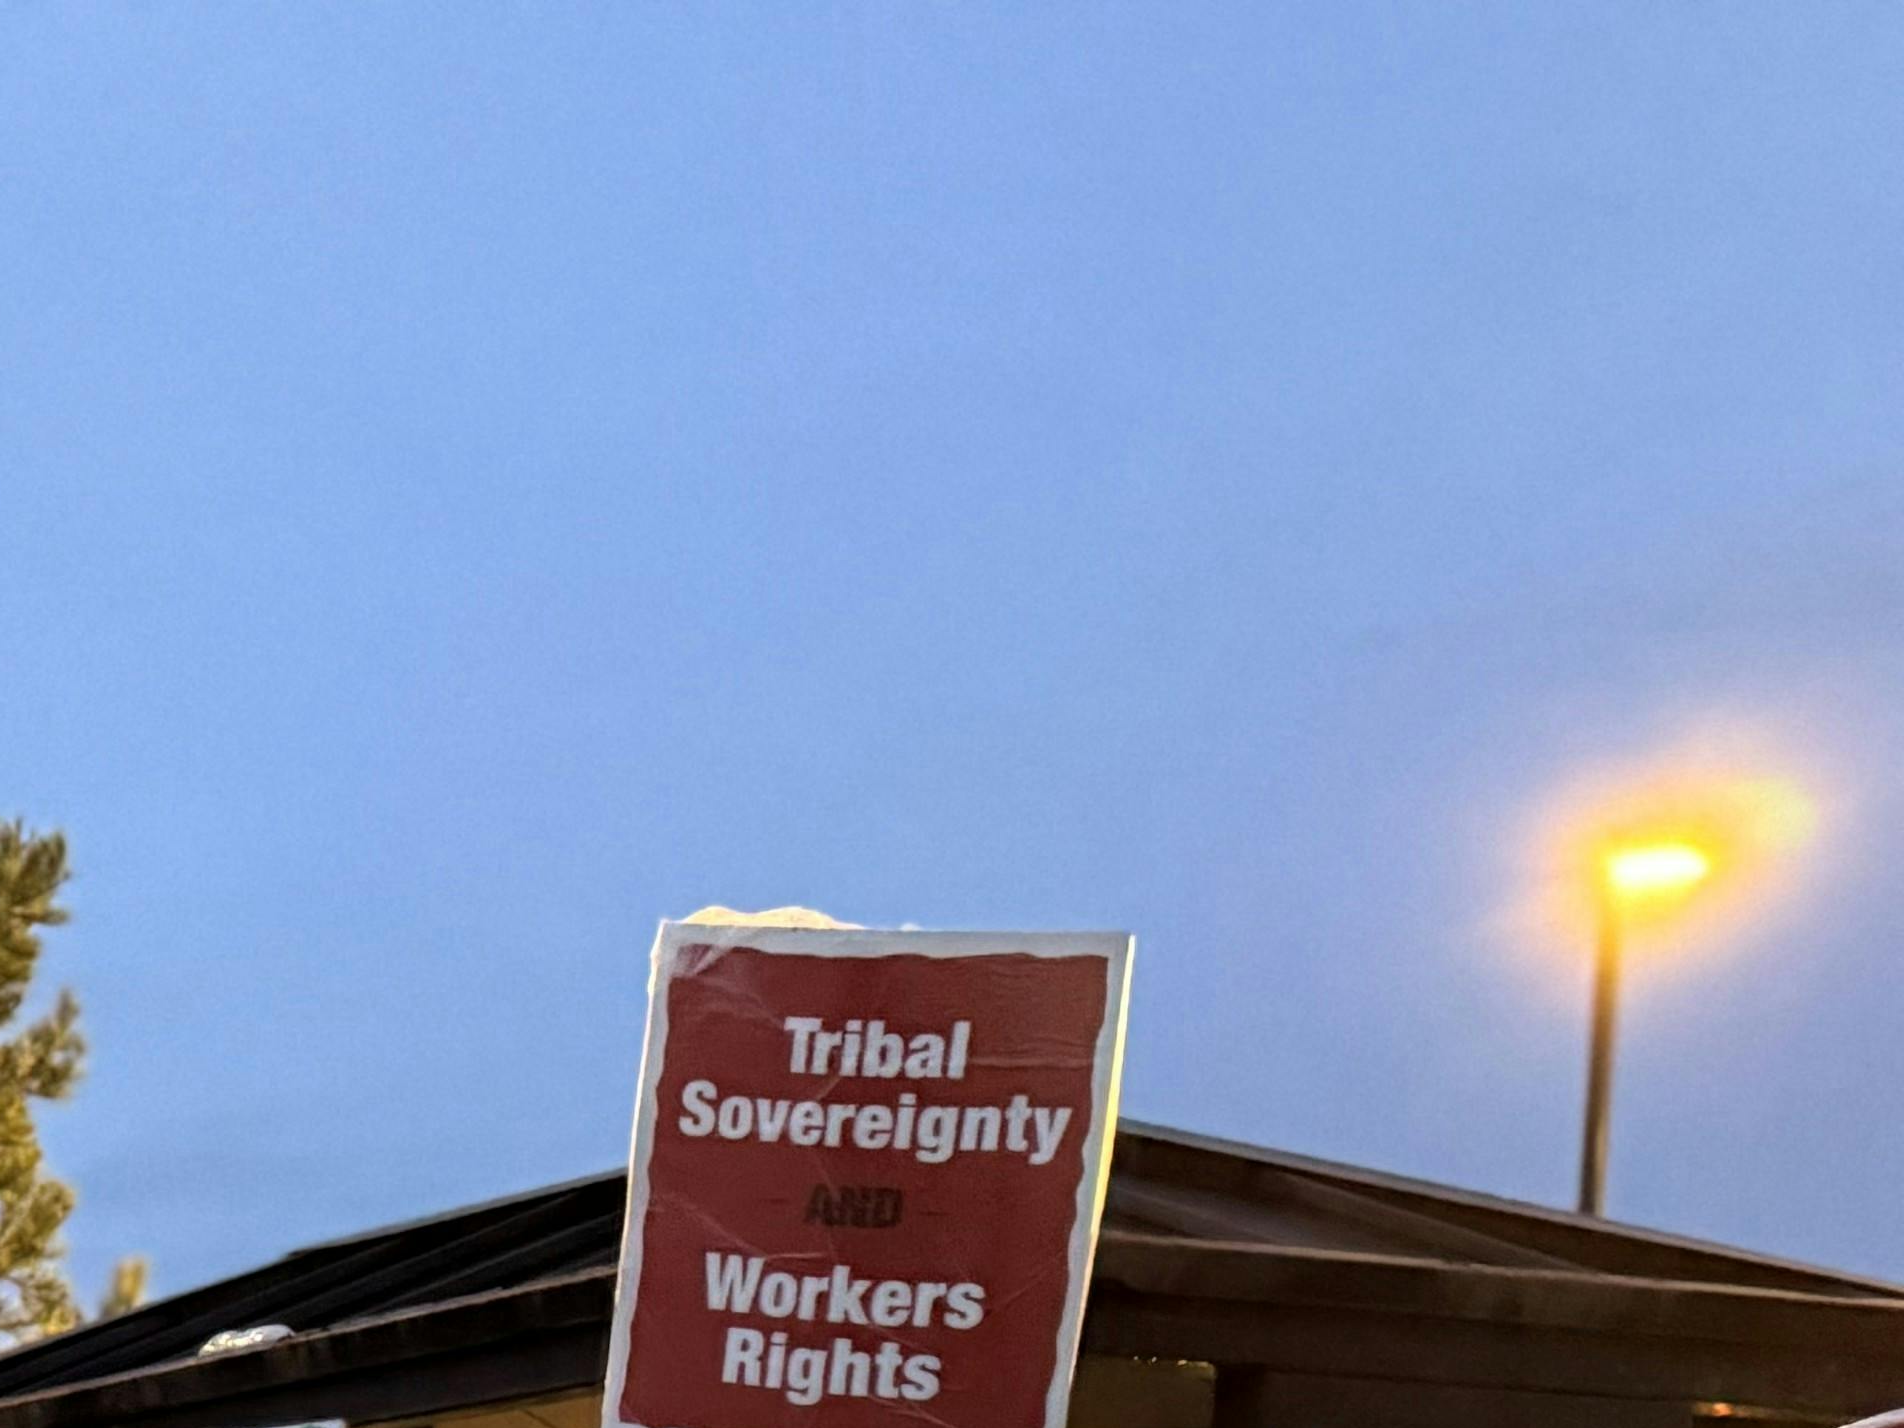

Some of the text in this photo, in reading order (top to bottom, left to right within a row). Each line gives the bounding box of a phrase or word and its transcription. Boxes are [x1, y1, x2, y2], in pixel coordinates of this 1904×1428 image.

[785, 1016, 972, 1080] Tribal
[678, 1080, 1073, 1165] Sovereignty
[705, 1252, 986, 1330] Workers
[721, 1328, 942, 1405] Rights
